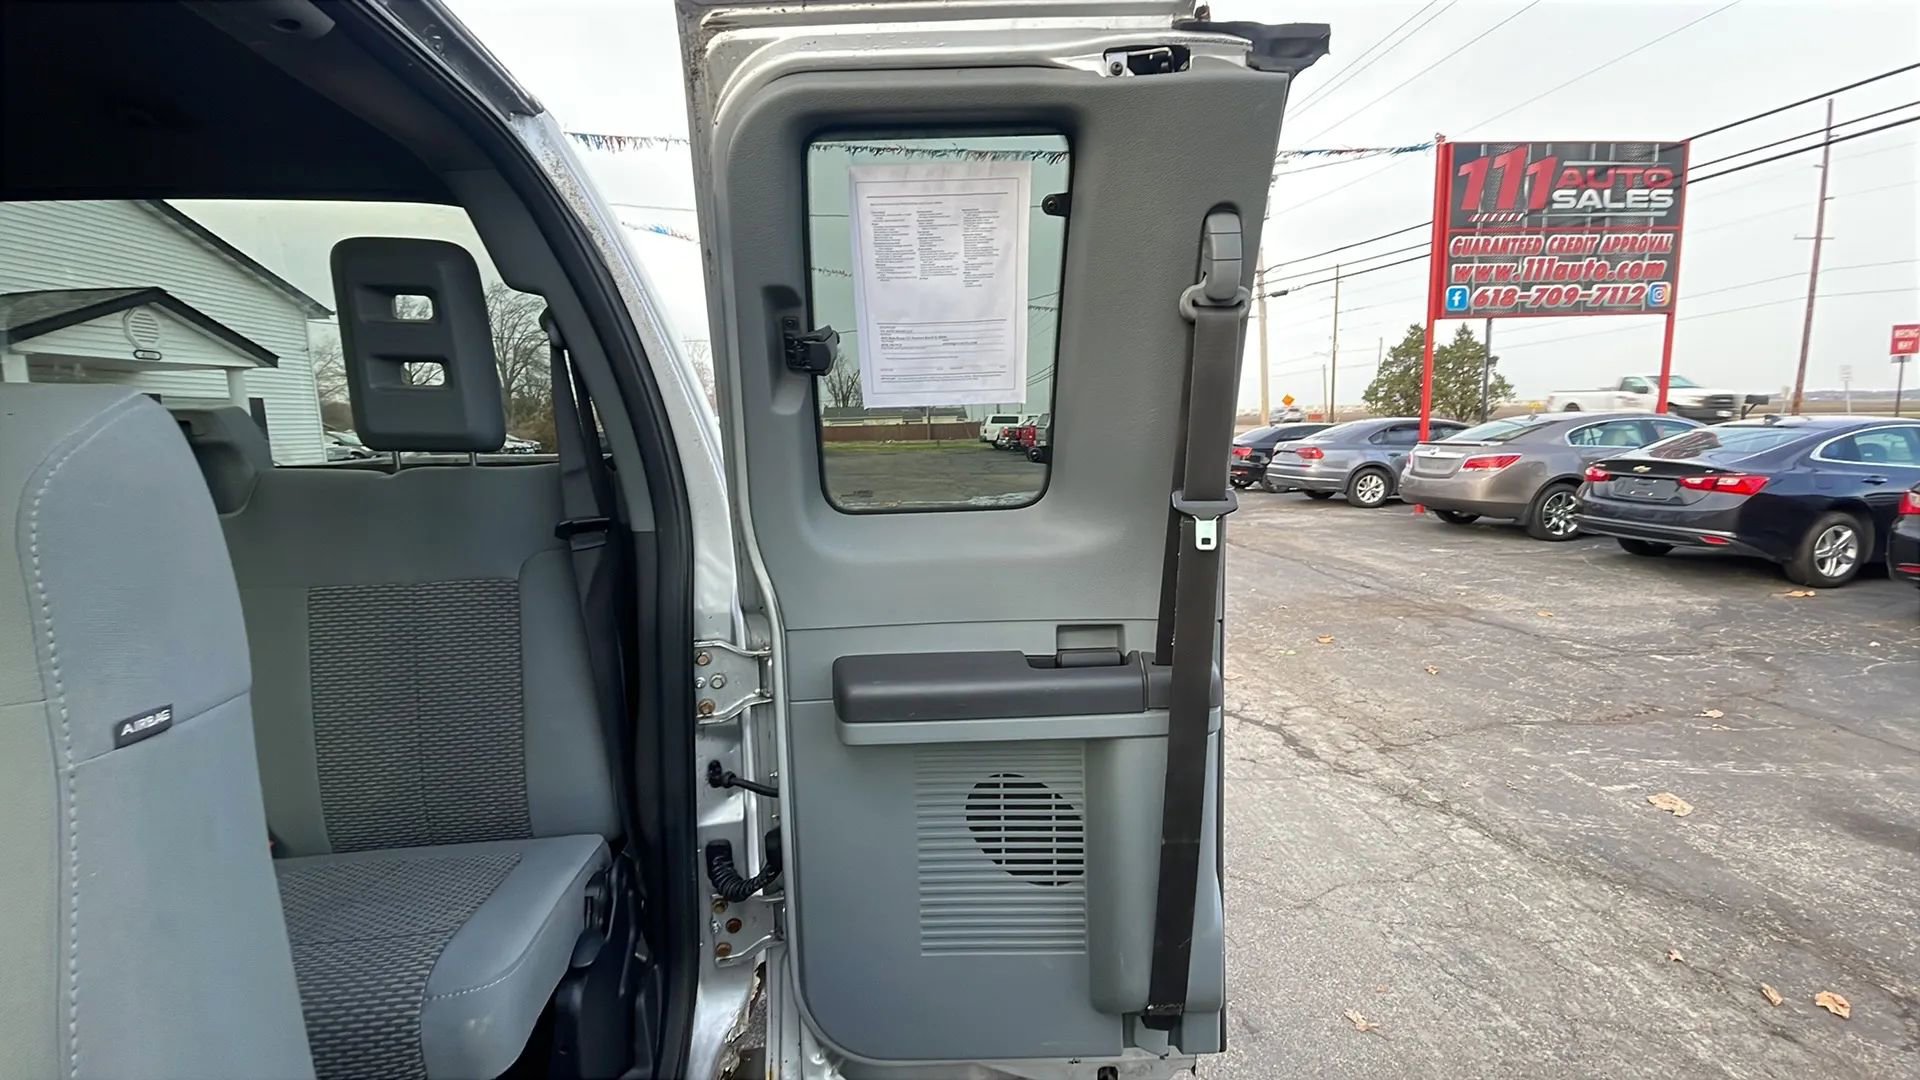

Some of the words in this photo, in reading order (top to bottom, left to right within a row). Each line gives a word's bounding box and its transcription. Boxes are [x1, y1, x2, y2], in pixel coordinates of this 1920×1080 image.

[1457, 145, 1559, 211] 111
[1554, 166, 1675, 190] AUTO
[1551, 188, 1675, 210] SALES
[1449, 235, 1544, 257] GUARANTEED
[1546, 234, 1599, 256] CREDIT
[1598, 233, 1674, 255] APPROVAL
[1451, 256, 1667, 284] www.111auto.com
[1471, 283, 1649, 309] 618-709-7112
